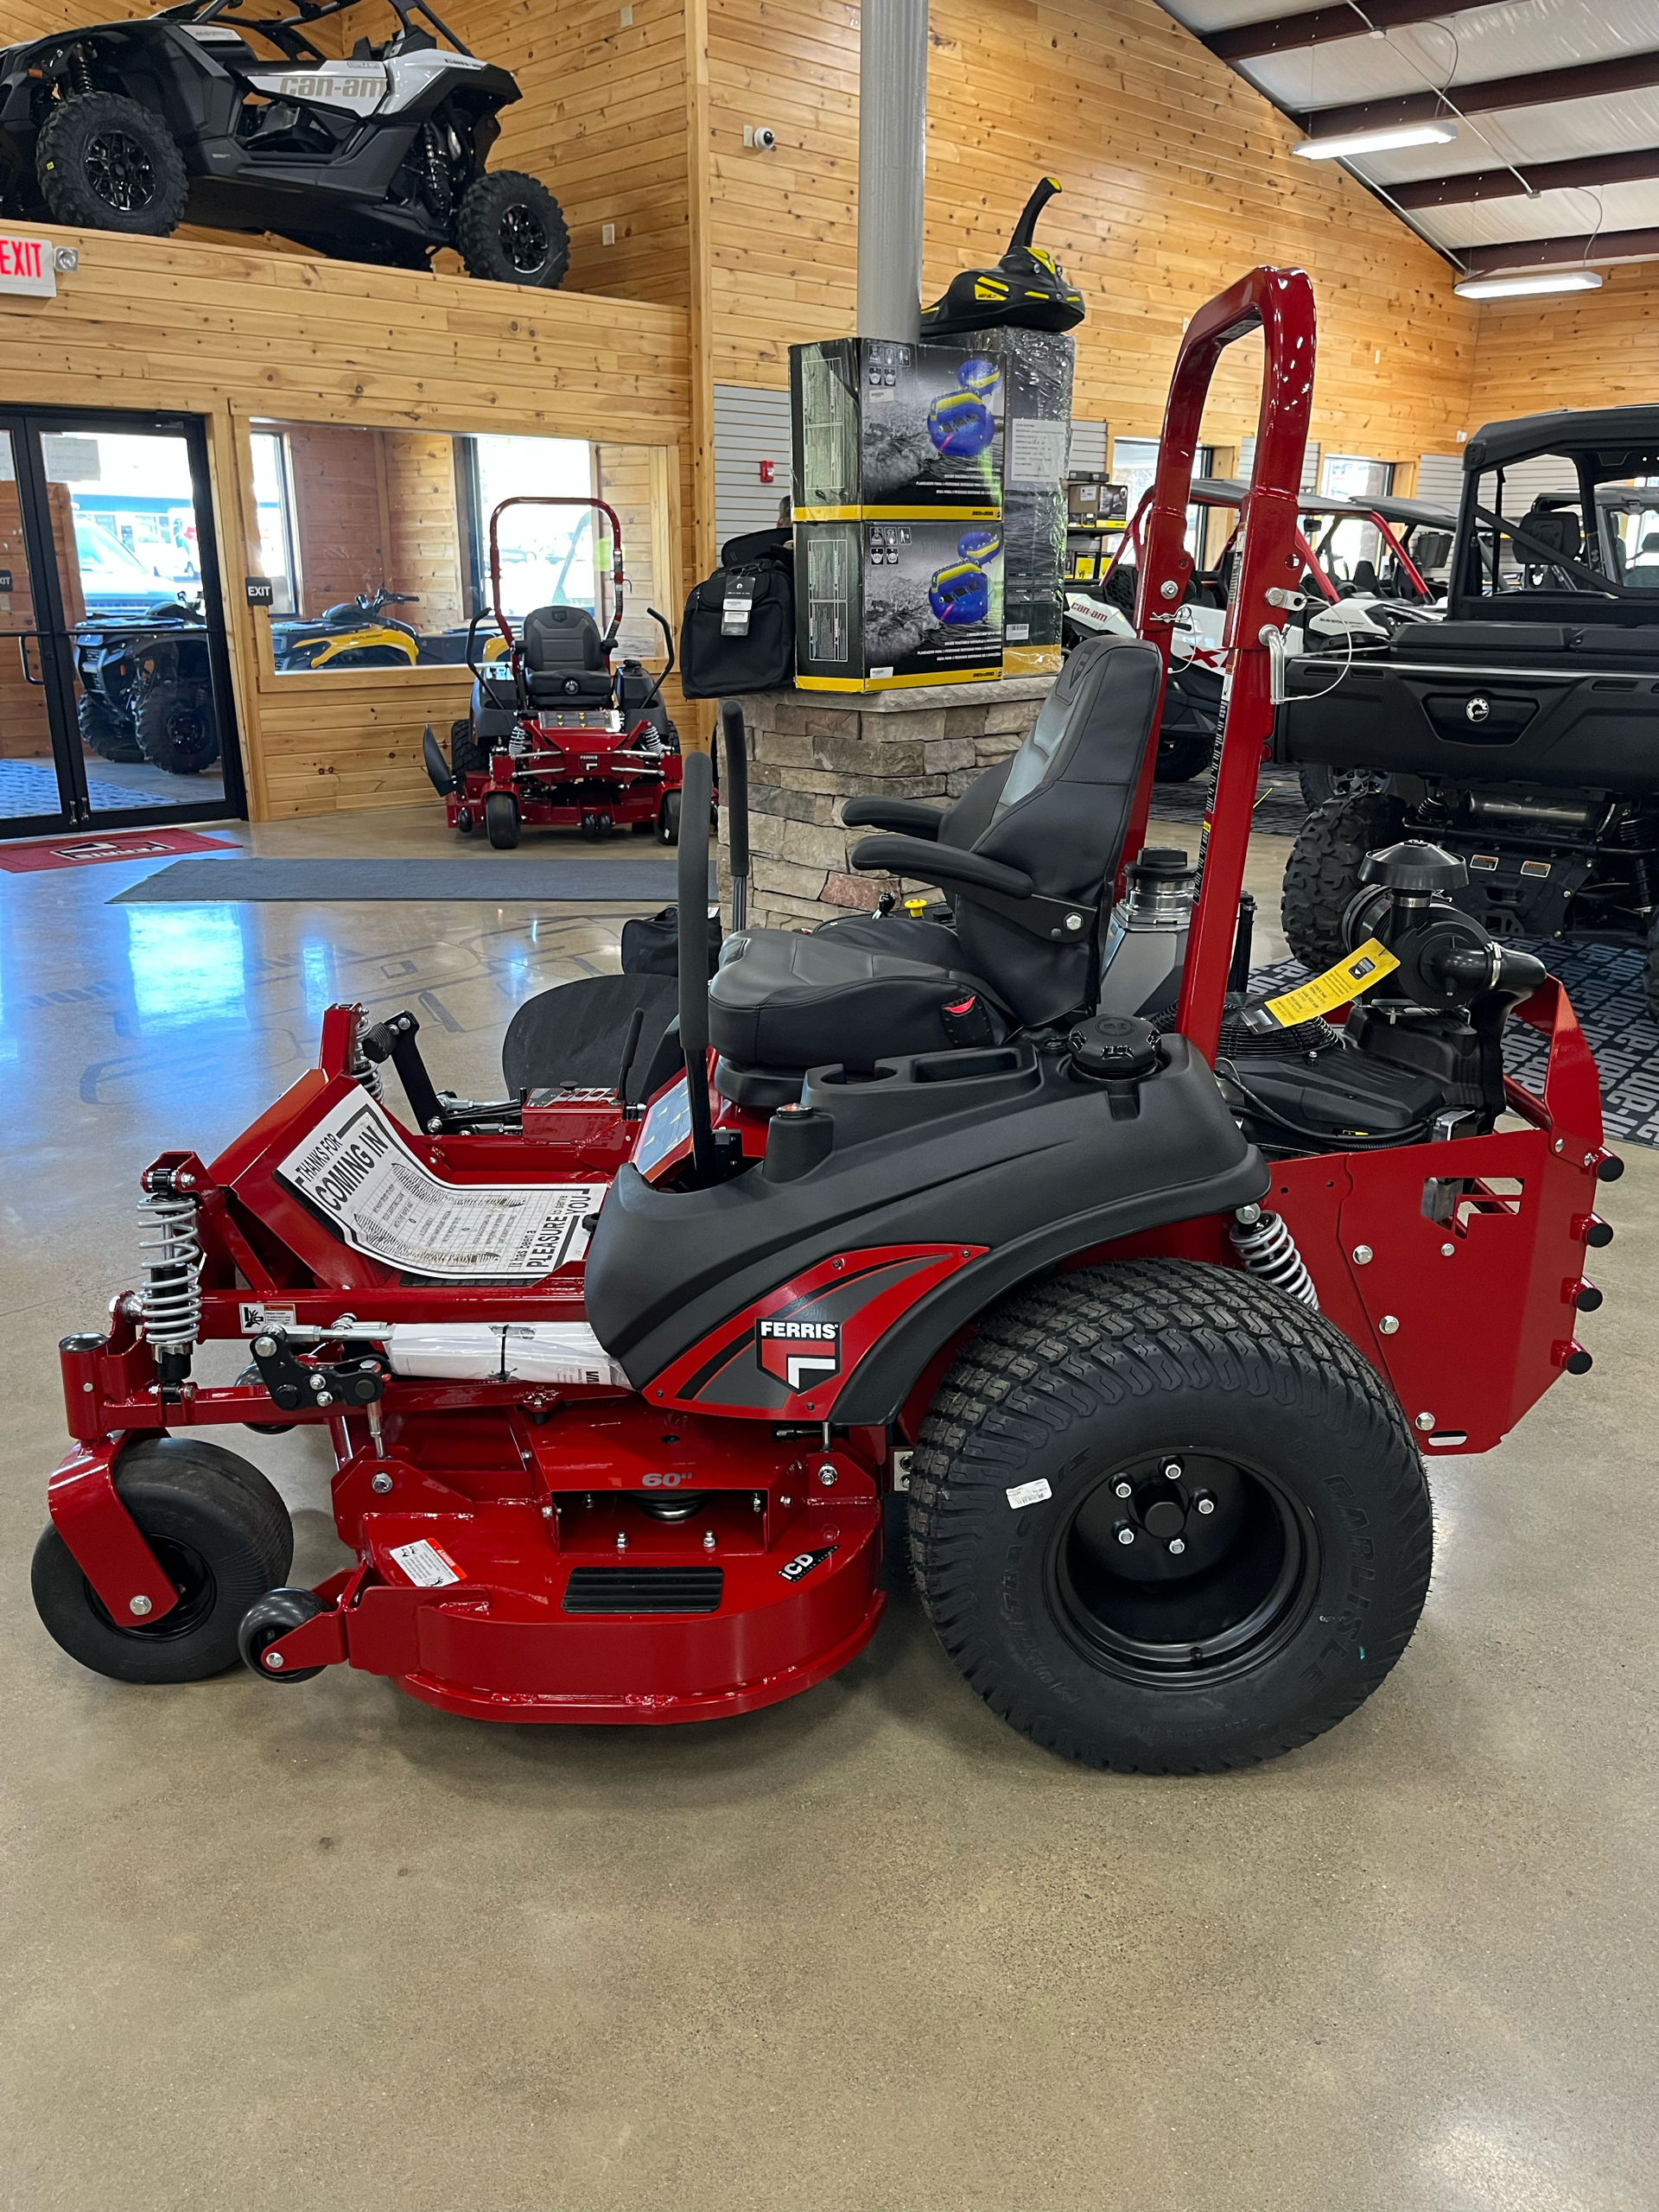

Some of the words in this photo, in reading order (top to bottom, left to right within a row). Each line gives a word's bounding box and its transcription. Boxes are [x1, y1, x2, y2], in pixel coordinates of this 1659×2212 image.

[280, 77, 387, 98] can-am
[0, 239, 41, 278] EXIT
[247, 586, 271, 597] EXIT
[1071, 601, 1109, 623] can-am
[295, 1145, 331, 1182] THANKS
[320, 1133, 343, 1156] FOR
[315, 1143, 376, 1211] COMING
[358, 1125, 389, 1158] IN
[564, 1196, 592, 1215] YOU
[515, 1232, 535, 1249] been
[526, 1216, 569, 1268] PLEASURE
[555, 1195, 569, 1209] serve
[510, 1249, 528, 1262] has
[760, 1321, 836, 1339] FERRIS
[642, 1472, 693, 1487] 60"
[778, 1554, 814, 1580] iCD
[1298, 1474, 1376, 1692] CARLISLE
